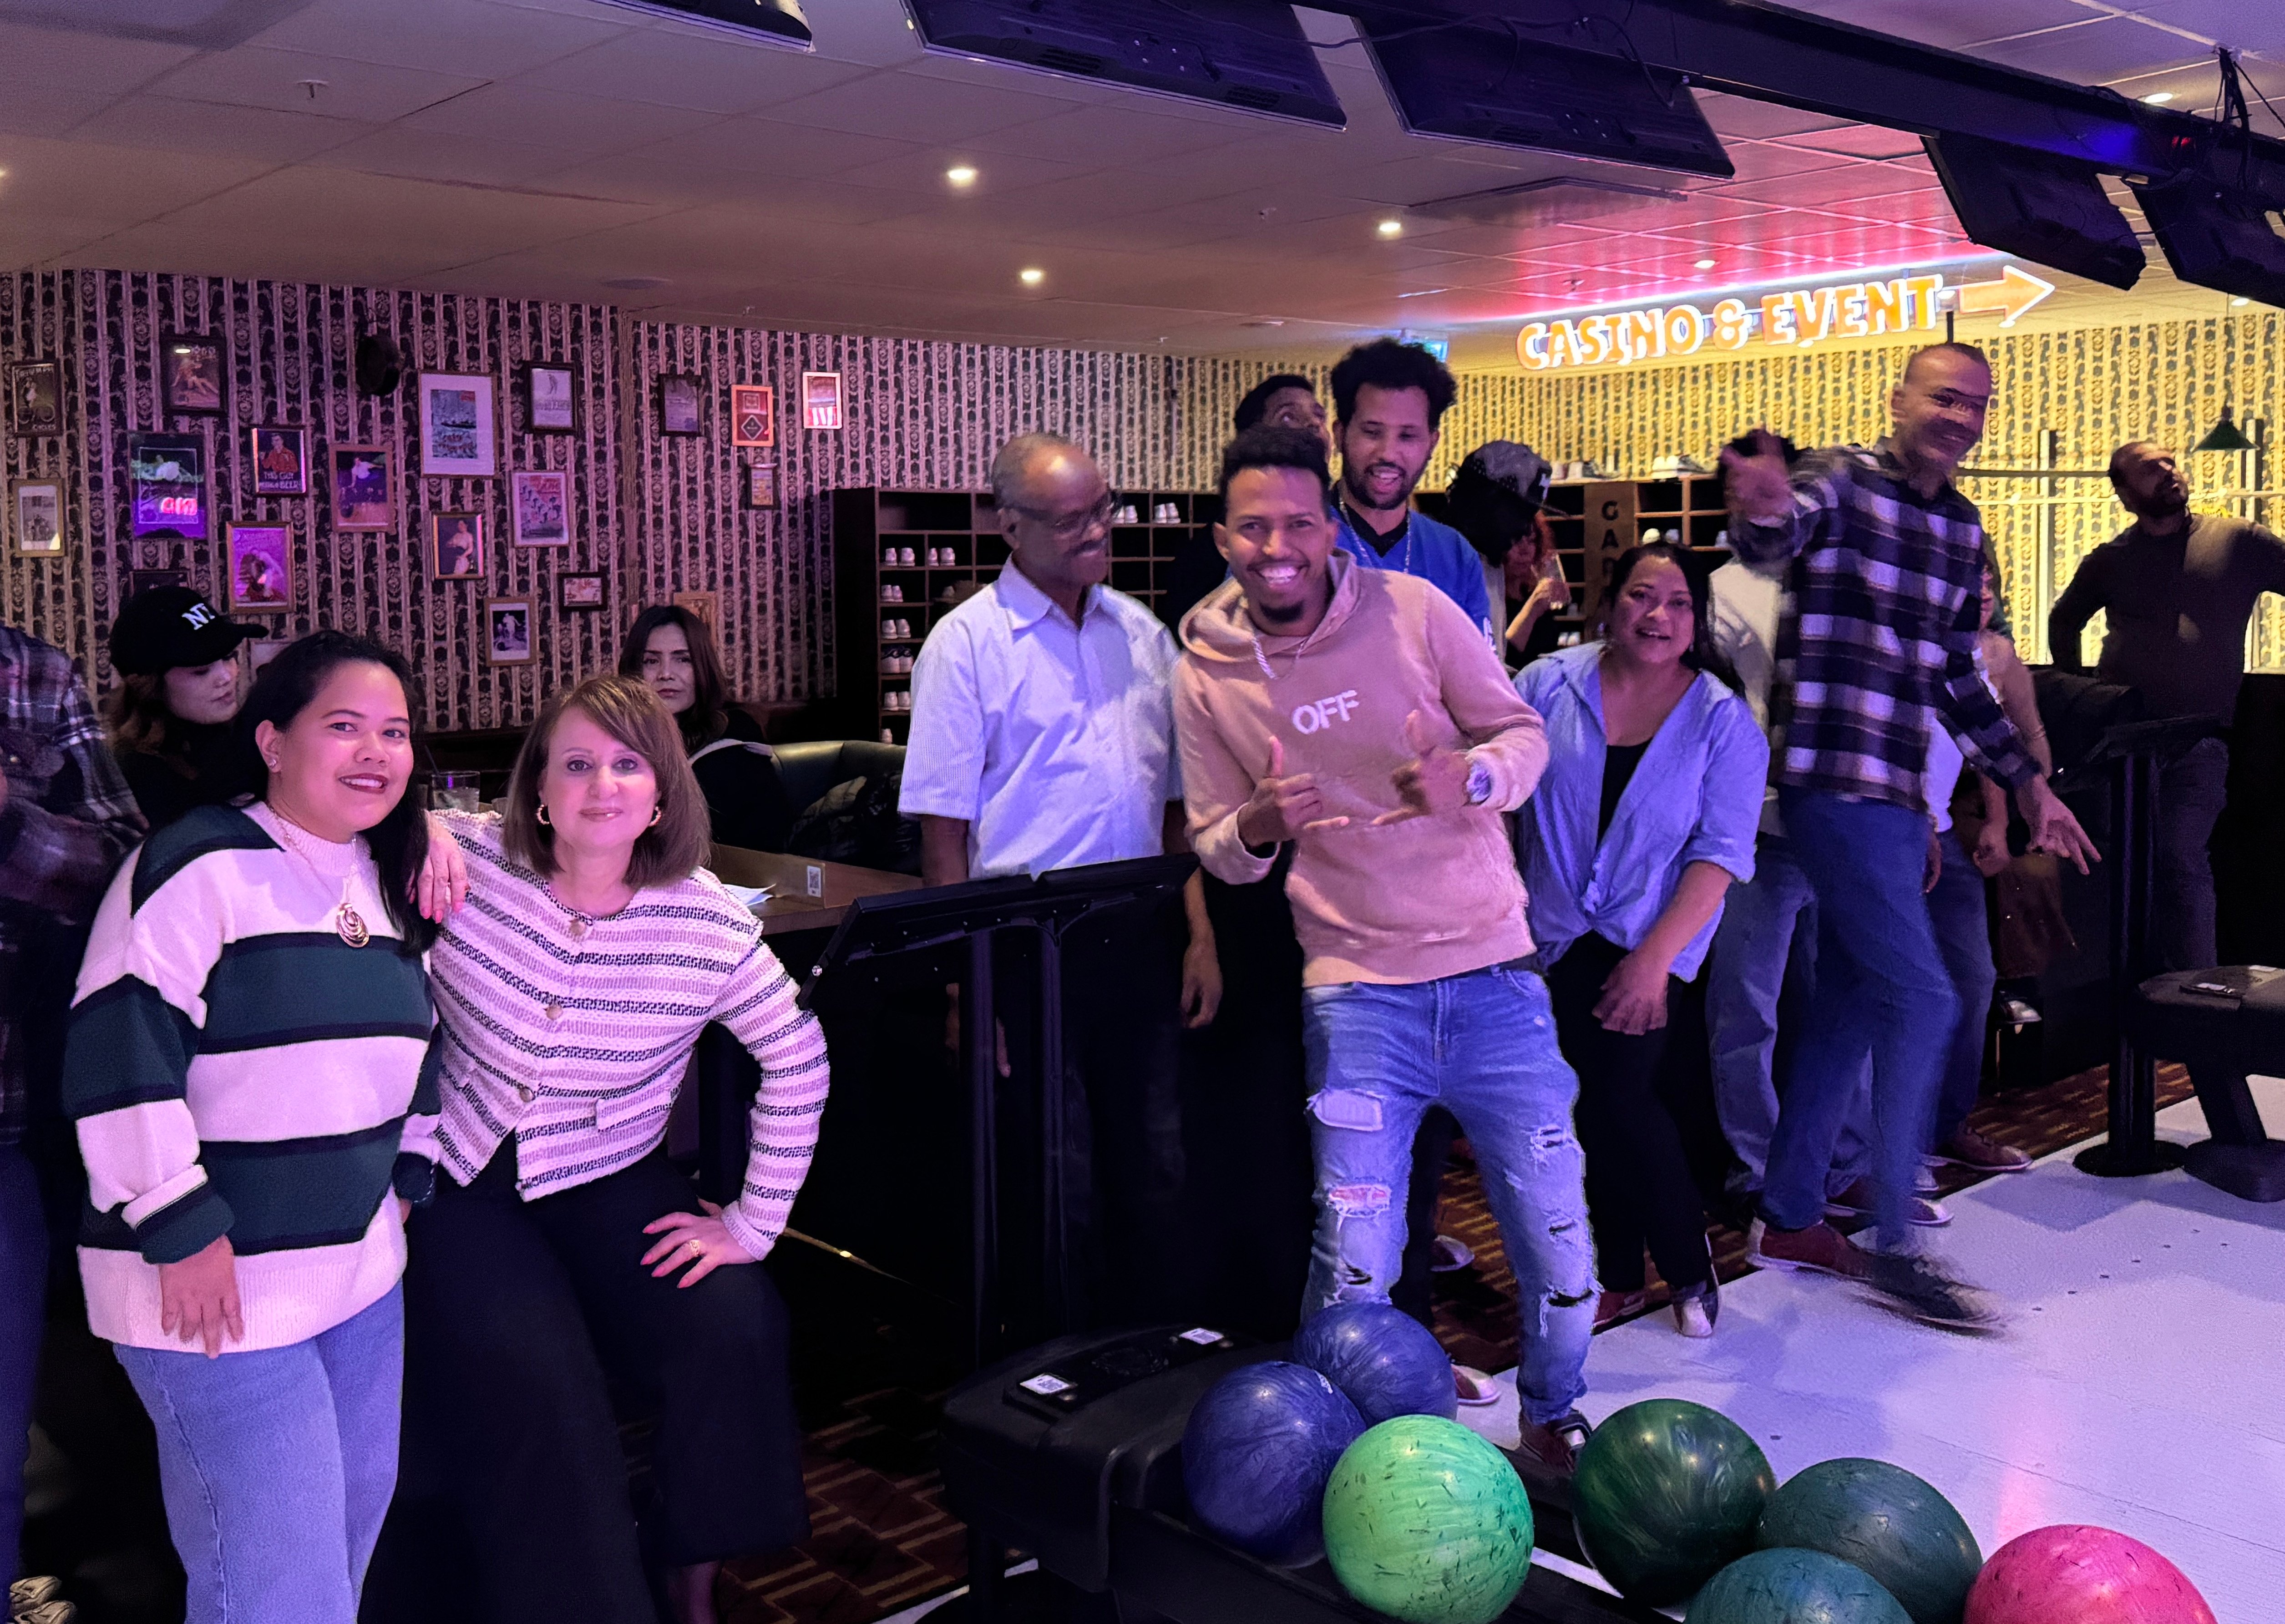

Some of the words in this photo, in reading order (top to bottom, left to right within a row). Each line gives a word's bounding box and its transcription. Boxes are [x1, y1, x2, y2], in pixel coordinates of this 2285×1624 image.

[1517, 304, 1704, 370] CASINO
[1712, 298, 1752, 350] &
[1761, 274, 1943, 345] EVENT
[1292, 690, 1360, 734] OFF
